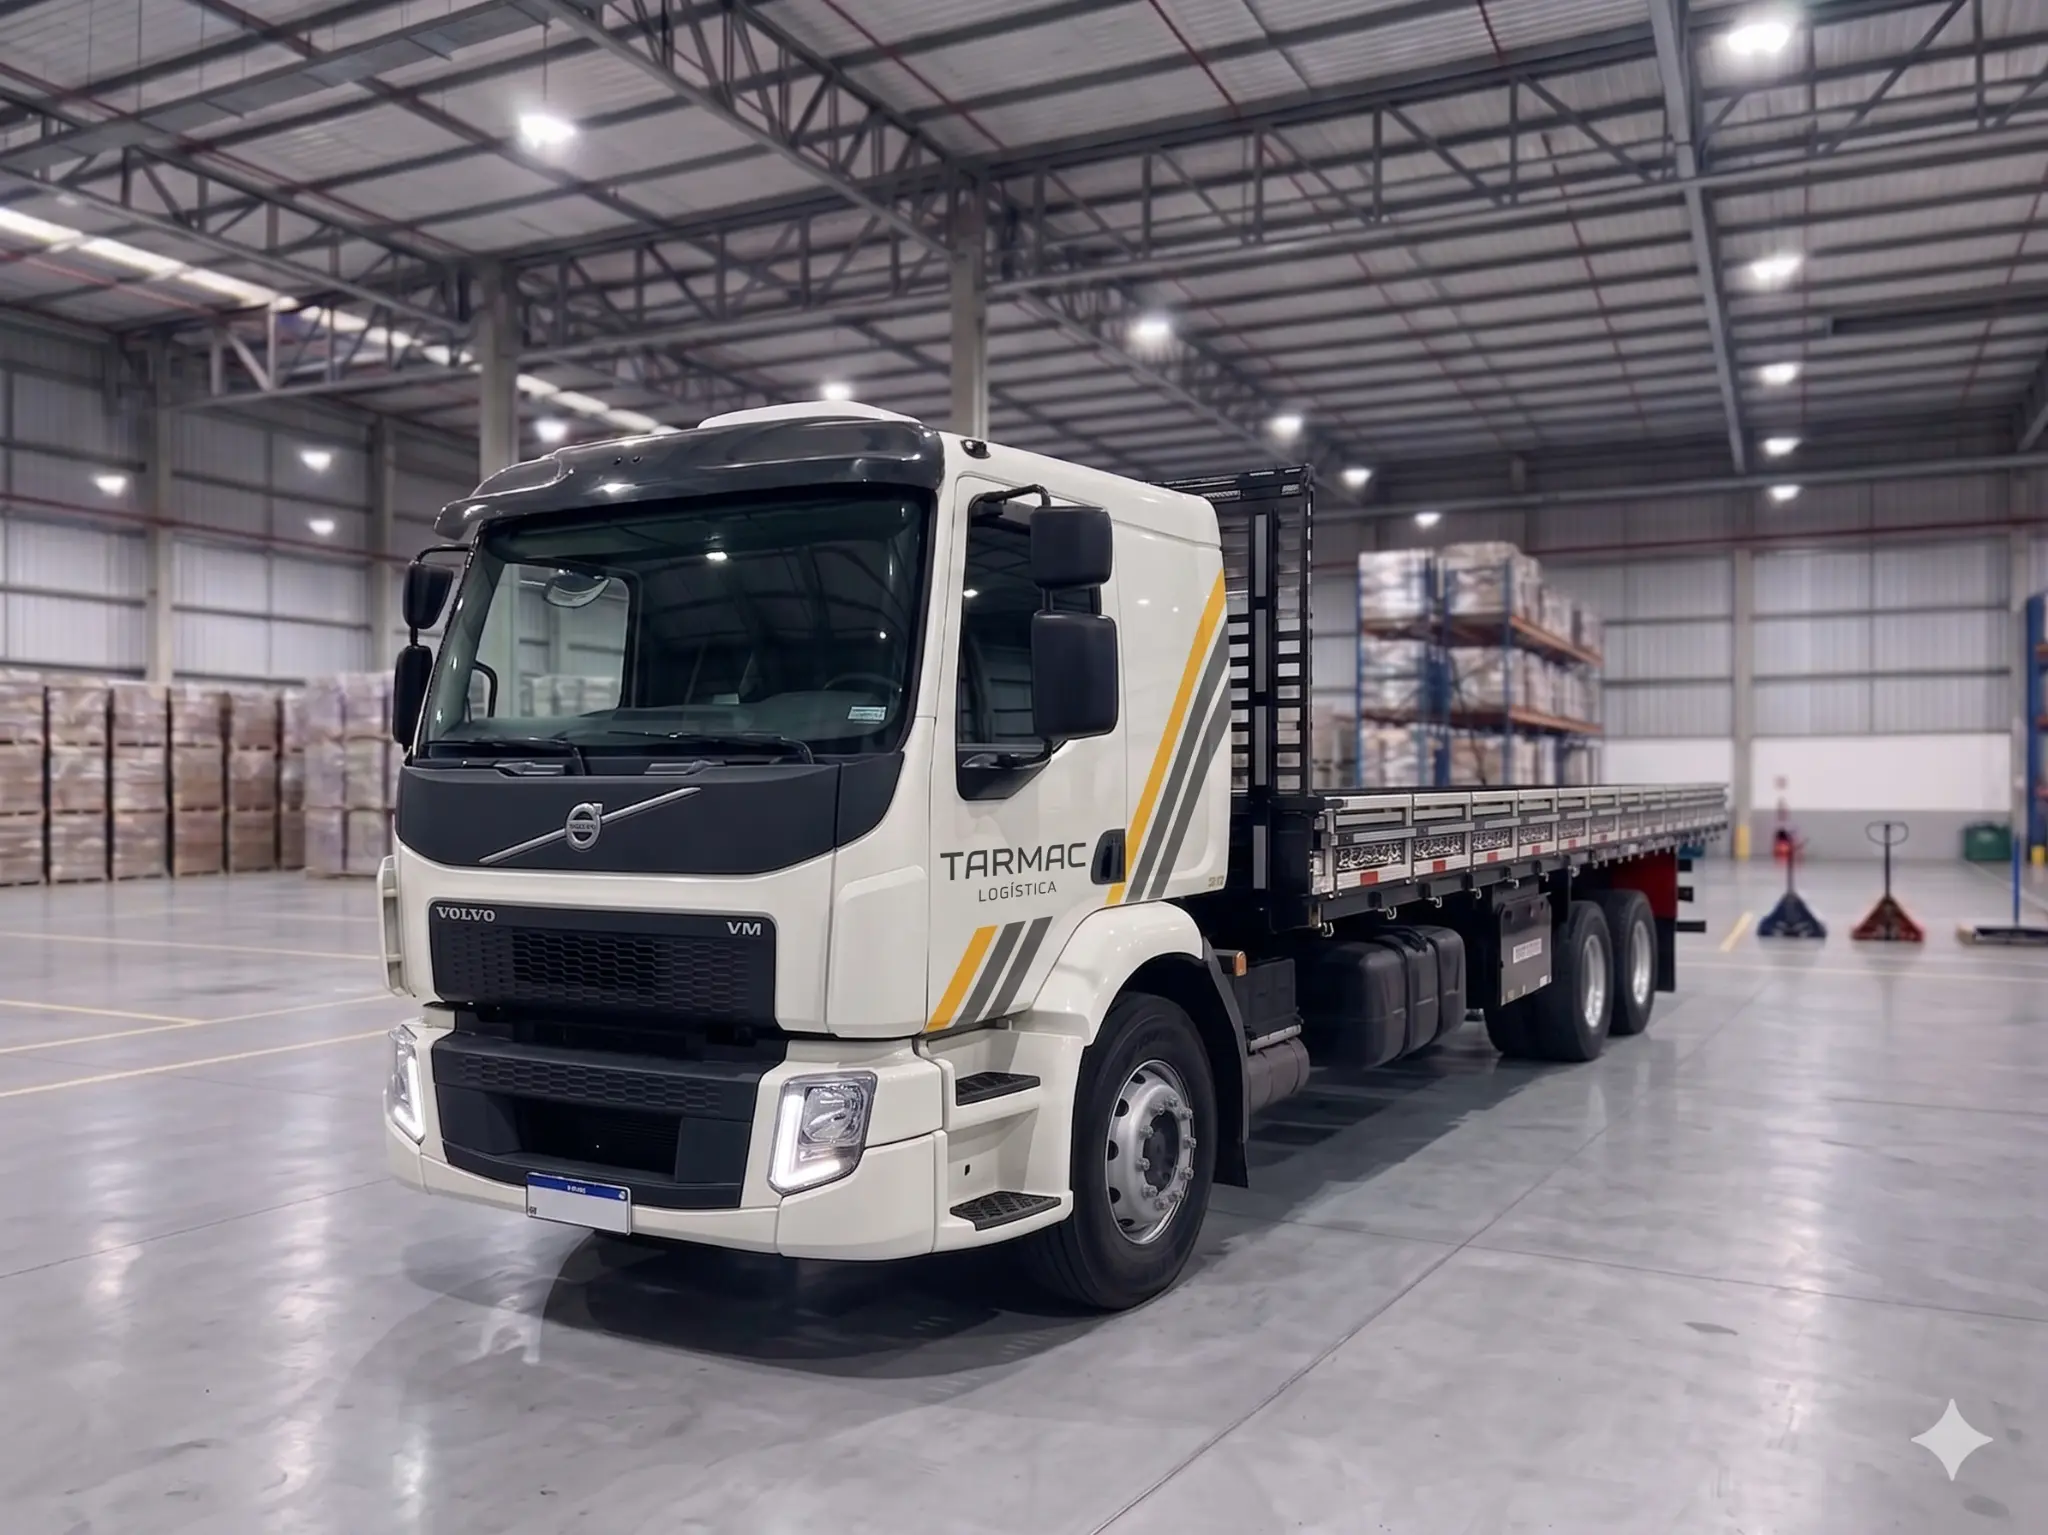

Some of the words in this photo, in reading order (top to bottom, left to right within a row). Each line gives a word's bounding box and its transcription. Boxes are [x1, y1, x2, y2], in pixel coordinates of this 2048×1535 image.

[940, 842, 1086, 881] TARMAC
[978, 881, 1057, 902] LOGÍSTICA
[436, 906, 496, 922] VOLVO
[726, 921, 762, 936] VM
